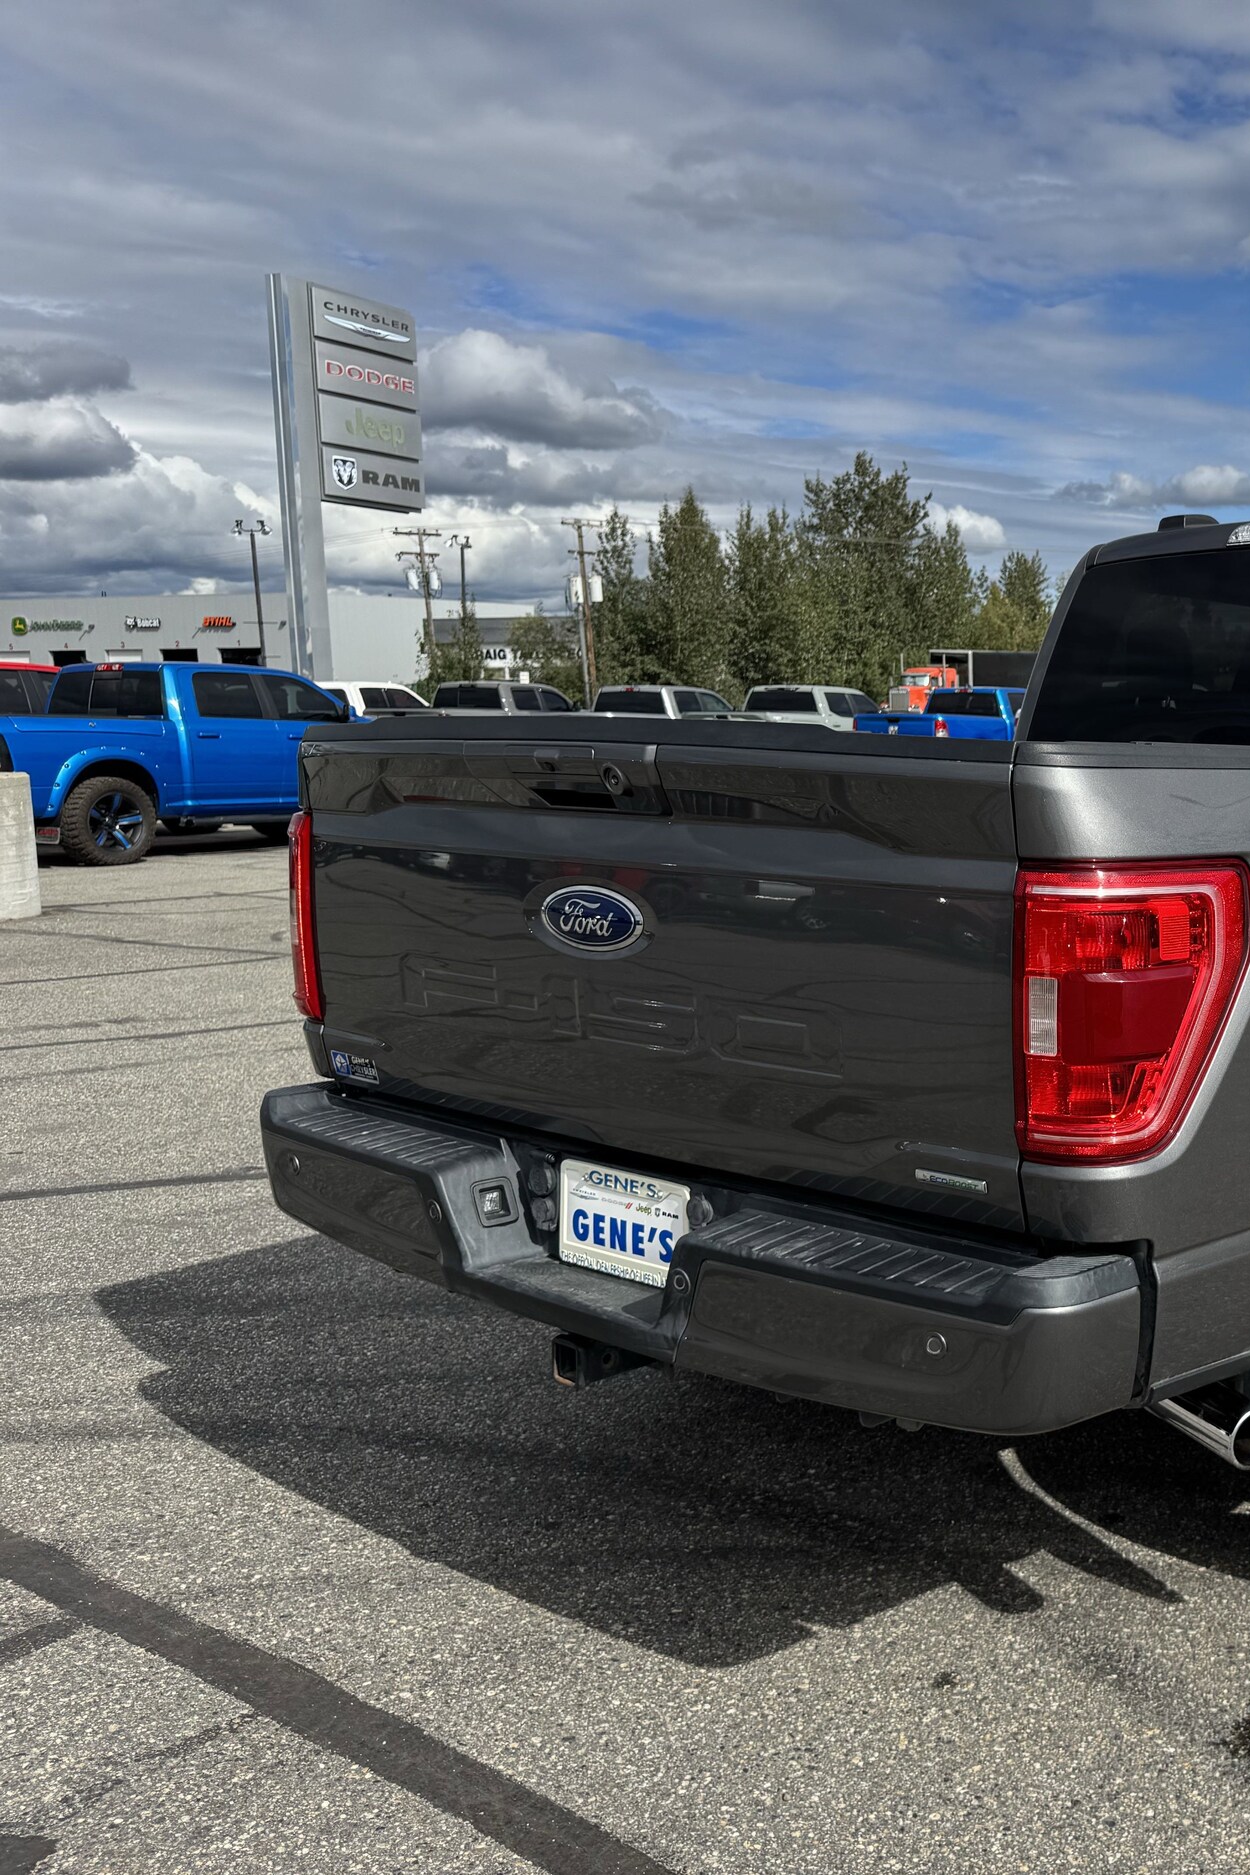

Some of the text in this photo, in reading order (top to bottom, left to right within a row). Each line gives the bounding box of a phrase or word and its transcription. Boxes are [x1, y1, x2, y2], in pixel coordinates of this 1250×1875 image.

[323, 301, 409, 333] CHRYSLER
[325, 359, 415, 394] DODGE
[345, 407, 405, 448] Jeep
[361, 470, 421, 492] RAM
[202, 615, 235, 627] STIHL
[560, 898, 618, 937] Ford
[588, 1170, 657, 1199] GENE'S
[636, 1203, 652, 1215] Jeep
[661, 1211, 679, 1220] RAM
[572, 1208, 674, 1263] GENE'S
